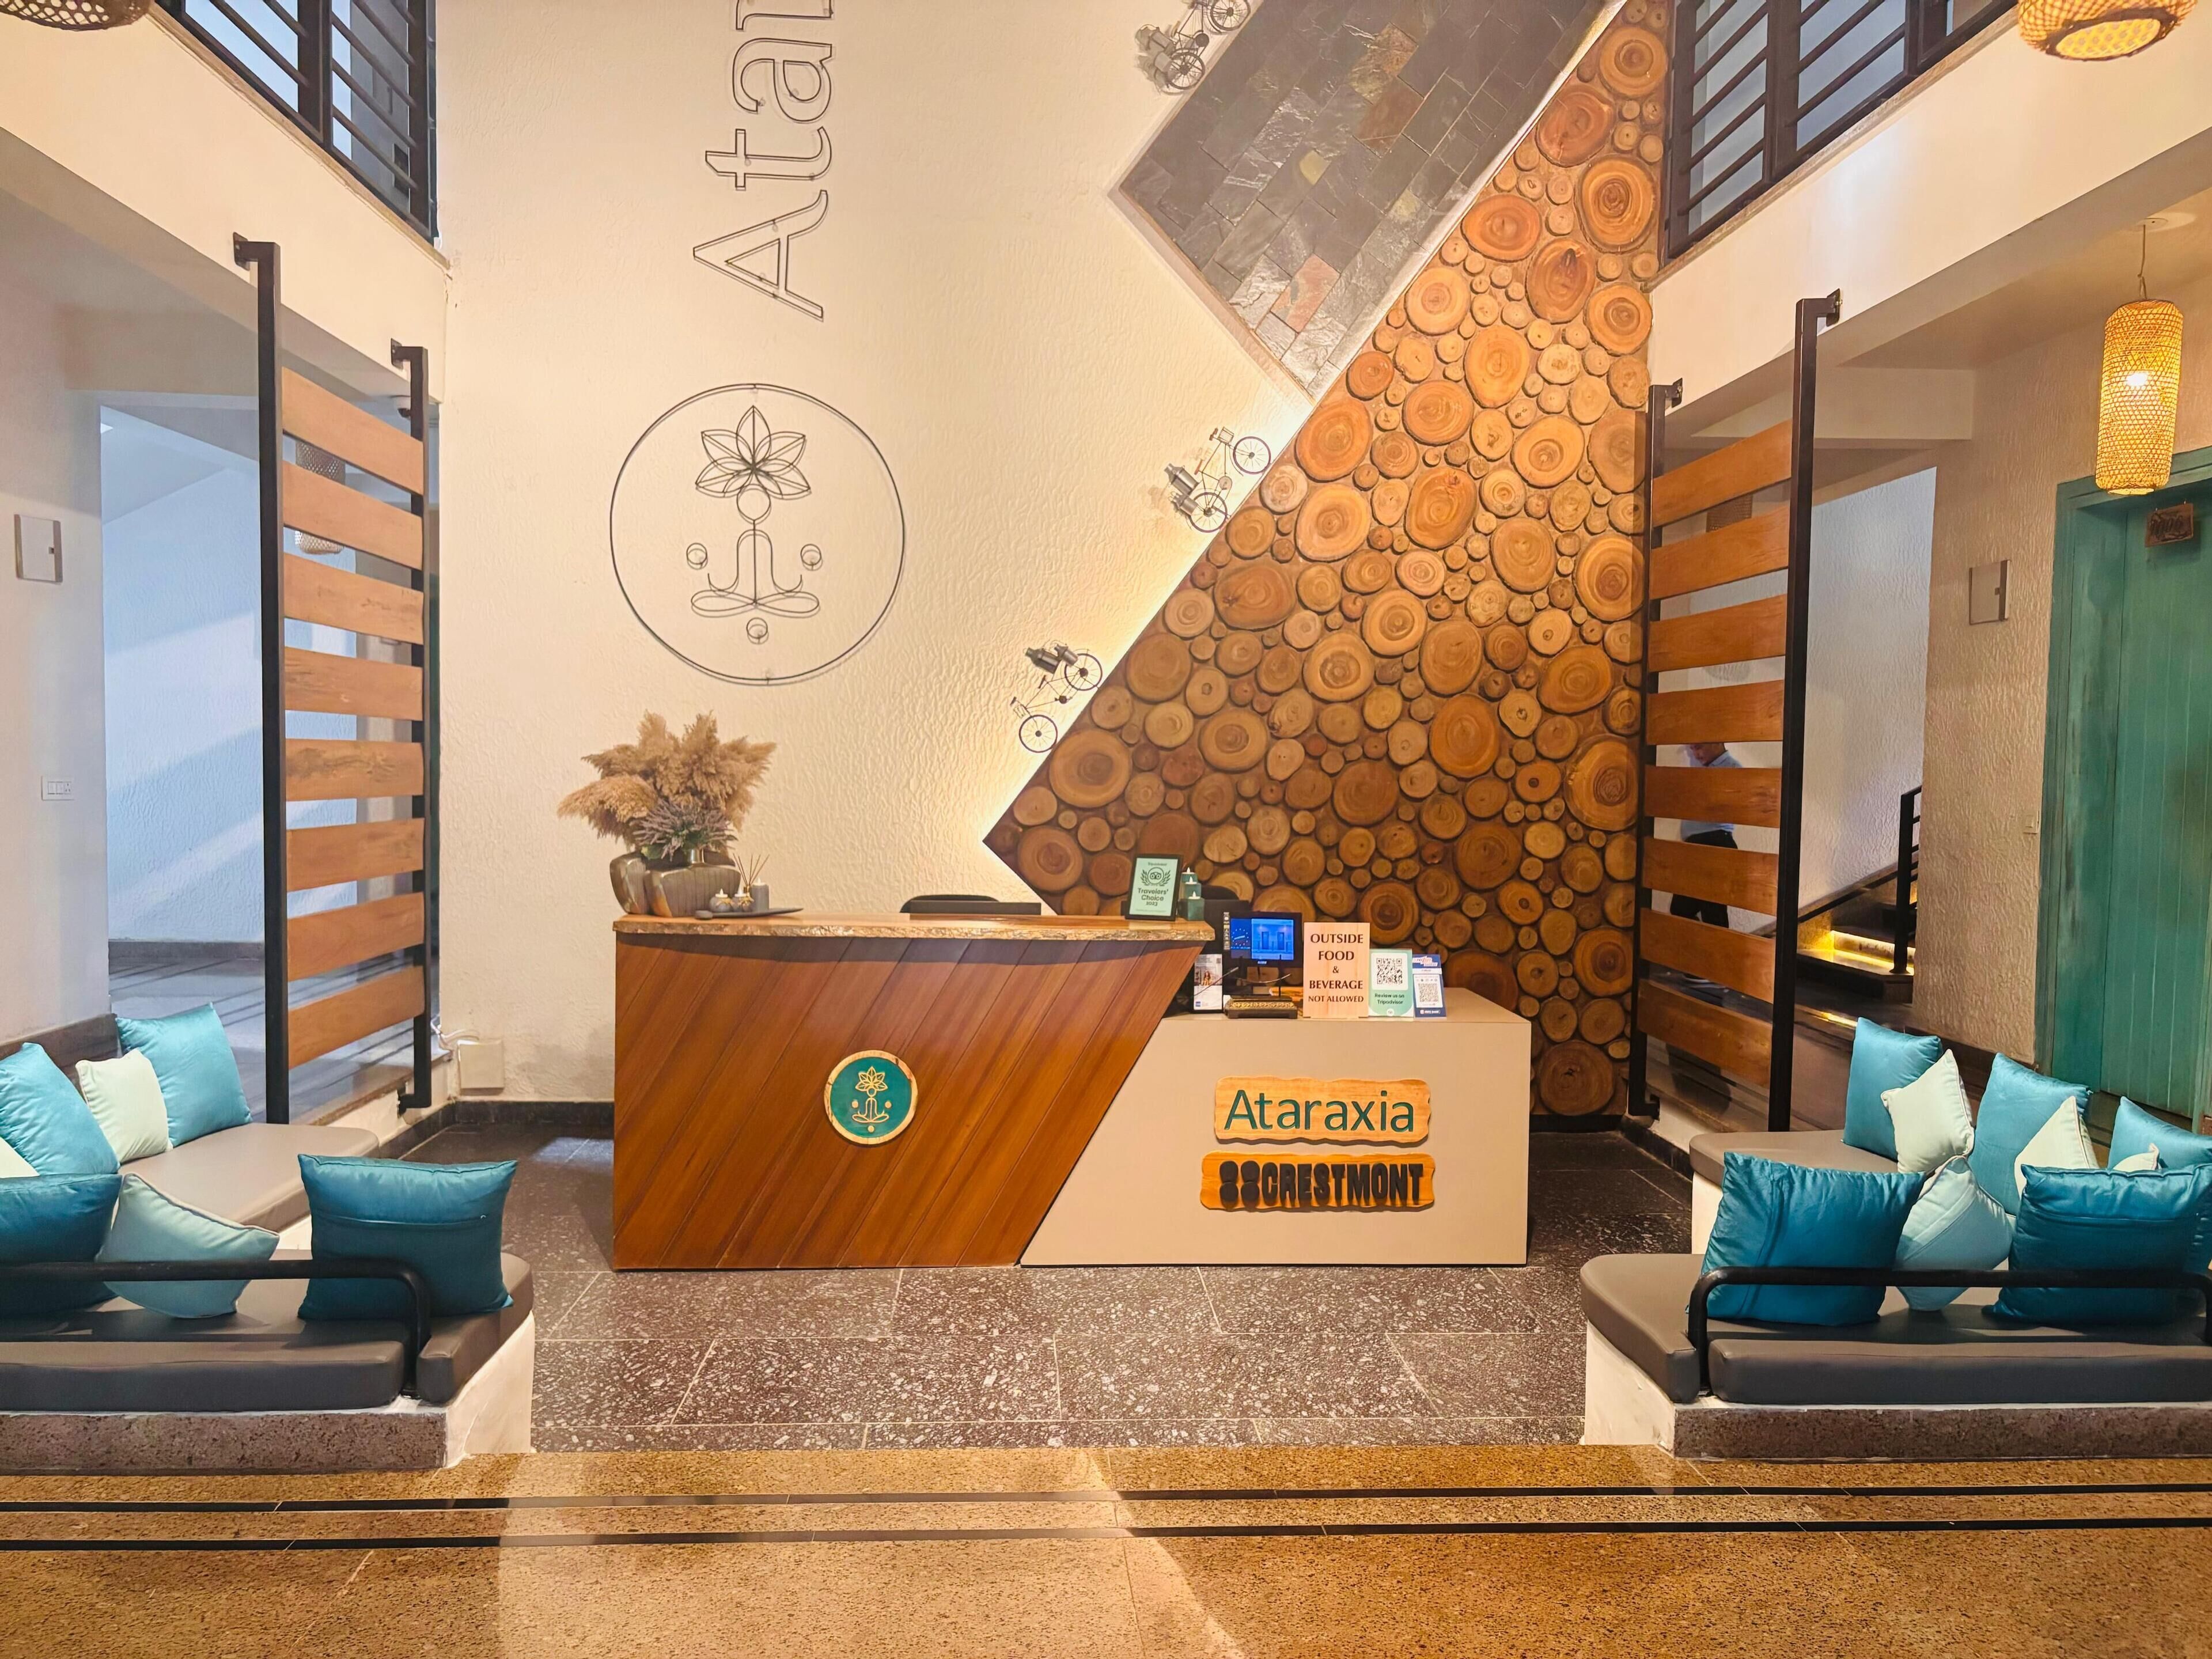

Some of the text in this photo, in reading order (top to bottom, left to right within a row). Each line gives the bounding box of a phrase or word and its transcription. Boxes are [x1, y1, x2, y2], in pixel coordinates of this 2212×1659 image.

[1310, 933, 1363, 944] OUTSIDE
[1318, 950, 1355, 961] FOOD
[1332, 965, 1339, 974] &
[1309, 980, 1363, 990] BEVERAGE
[1224, 1089, 1414, 1132] Ataraxia
